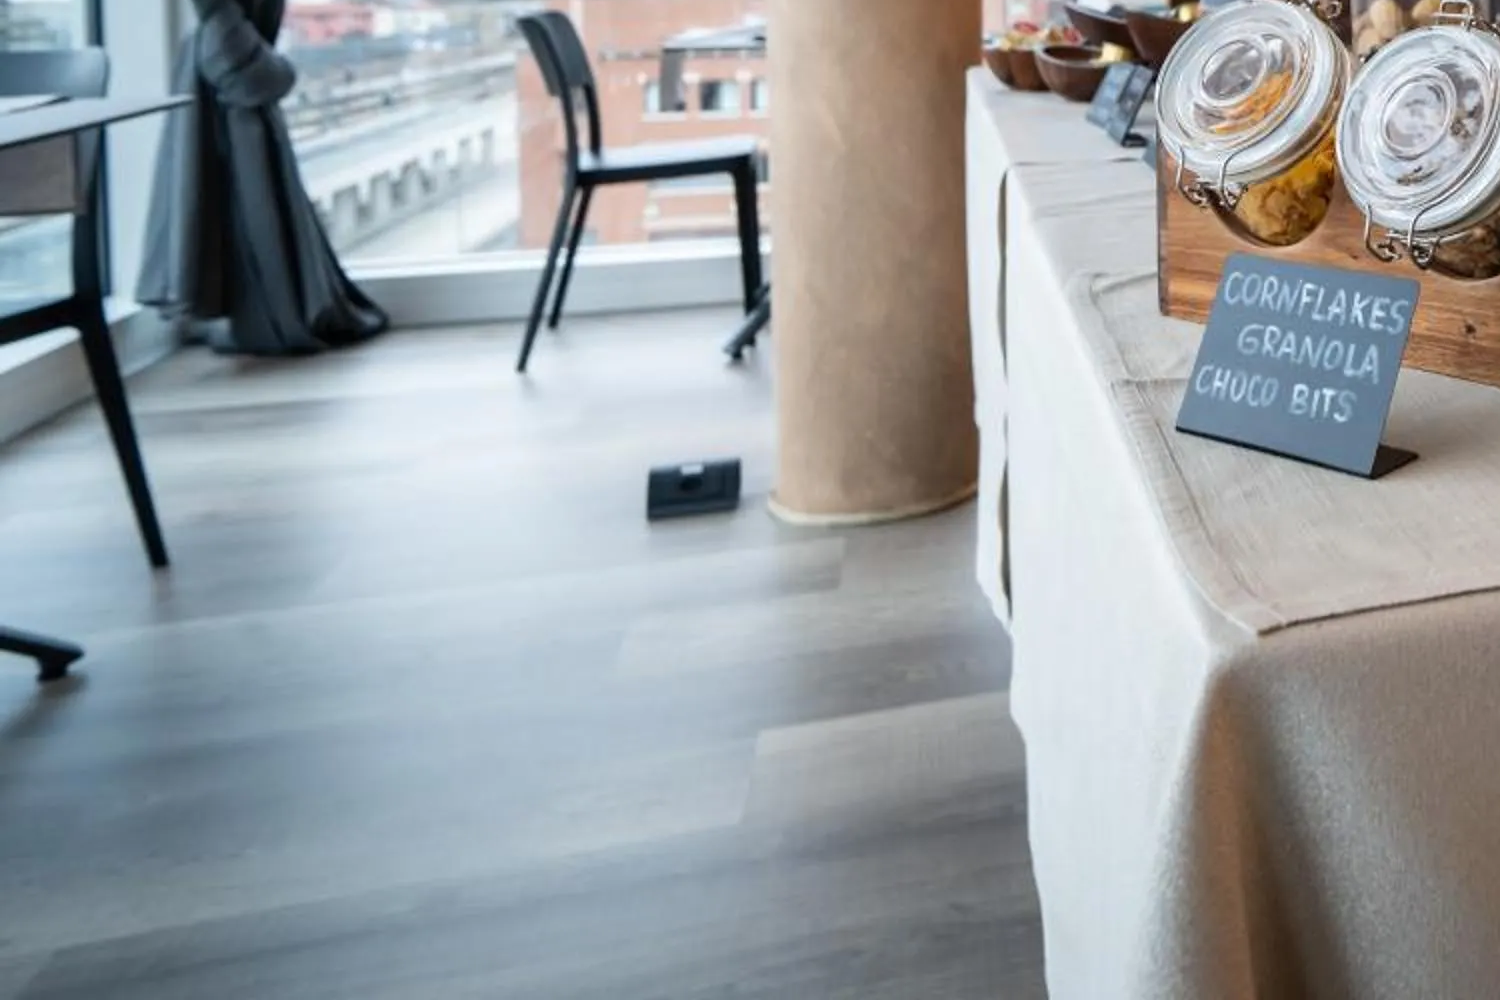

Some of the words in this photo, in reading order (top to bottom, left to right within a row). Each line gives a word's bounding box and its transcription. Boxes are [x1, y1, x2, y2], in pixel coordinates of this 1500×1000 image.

[1223, 271, 1409, 334] CORNFLAKES
[1237, 324, 1379, 384] GRANOLA
[1195, 364, 1279, 407] CHOCO
[1287, 383, 1357, 422] BITS
